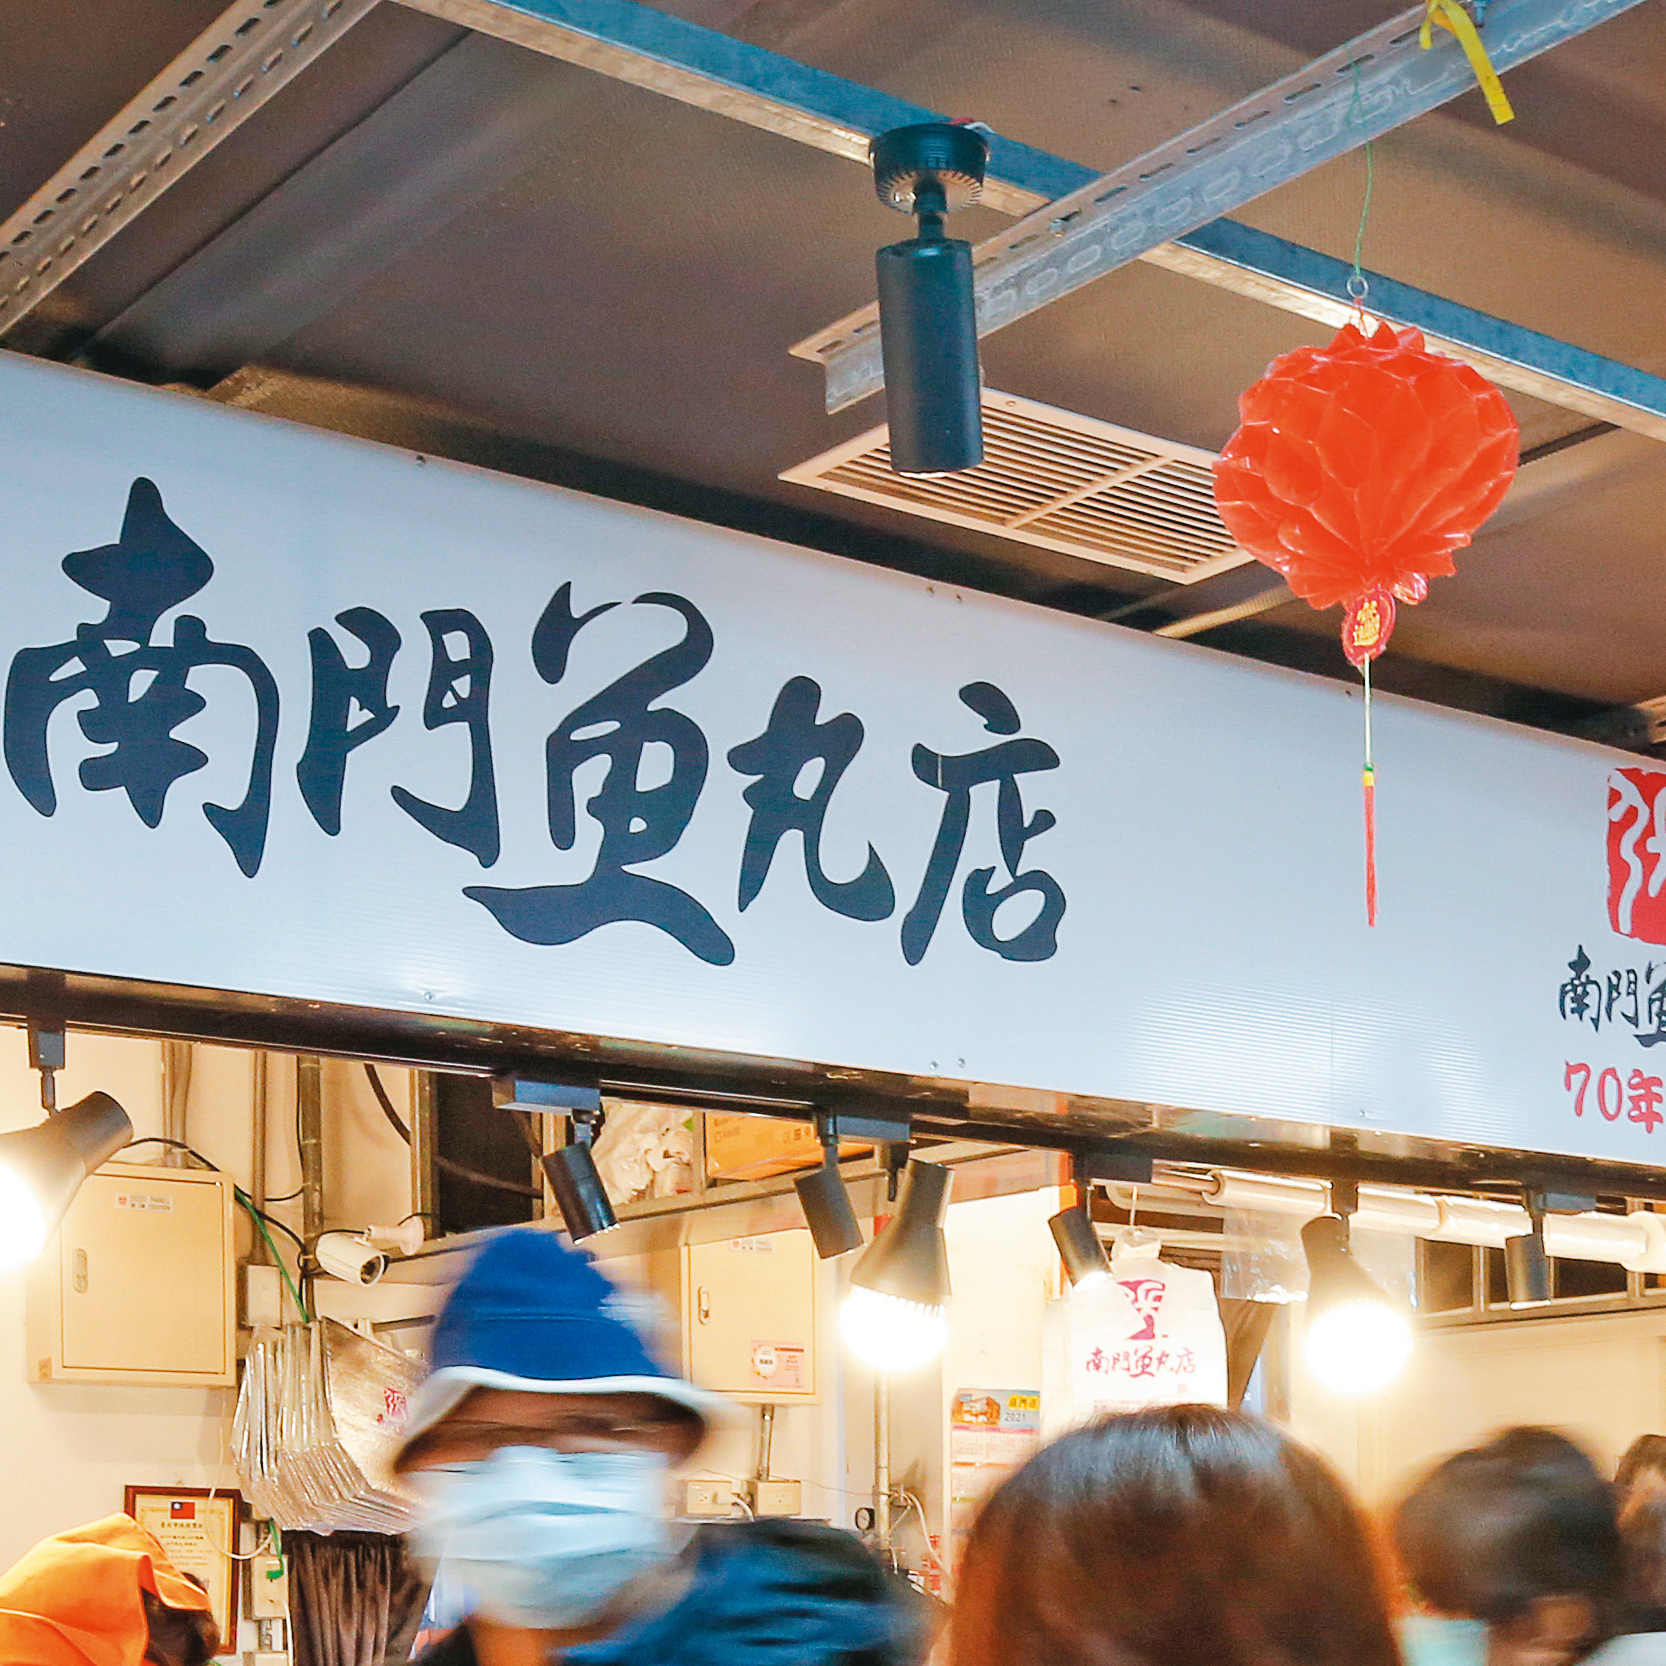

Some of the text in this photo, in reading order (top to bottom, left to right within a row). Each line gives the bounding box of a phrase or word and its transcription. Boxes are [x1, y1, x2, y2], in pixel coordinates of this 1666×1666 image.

[3, 476, 1067, 967] 南門魚丸店
[1085, 1345, 1196, 1378] 南門魚丸店
[1004, 1411, 1027, 1423] 2021
